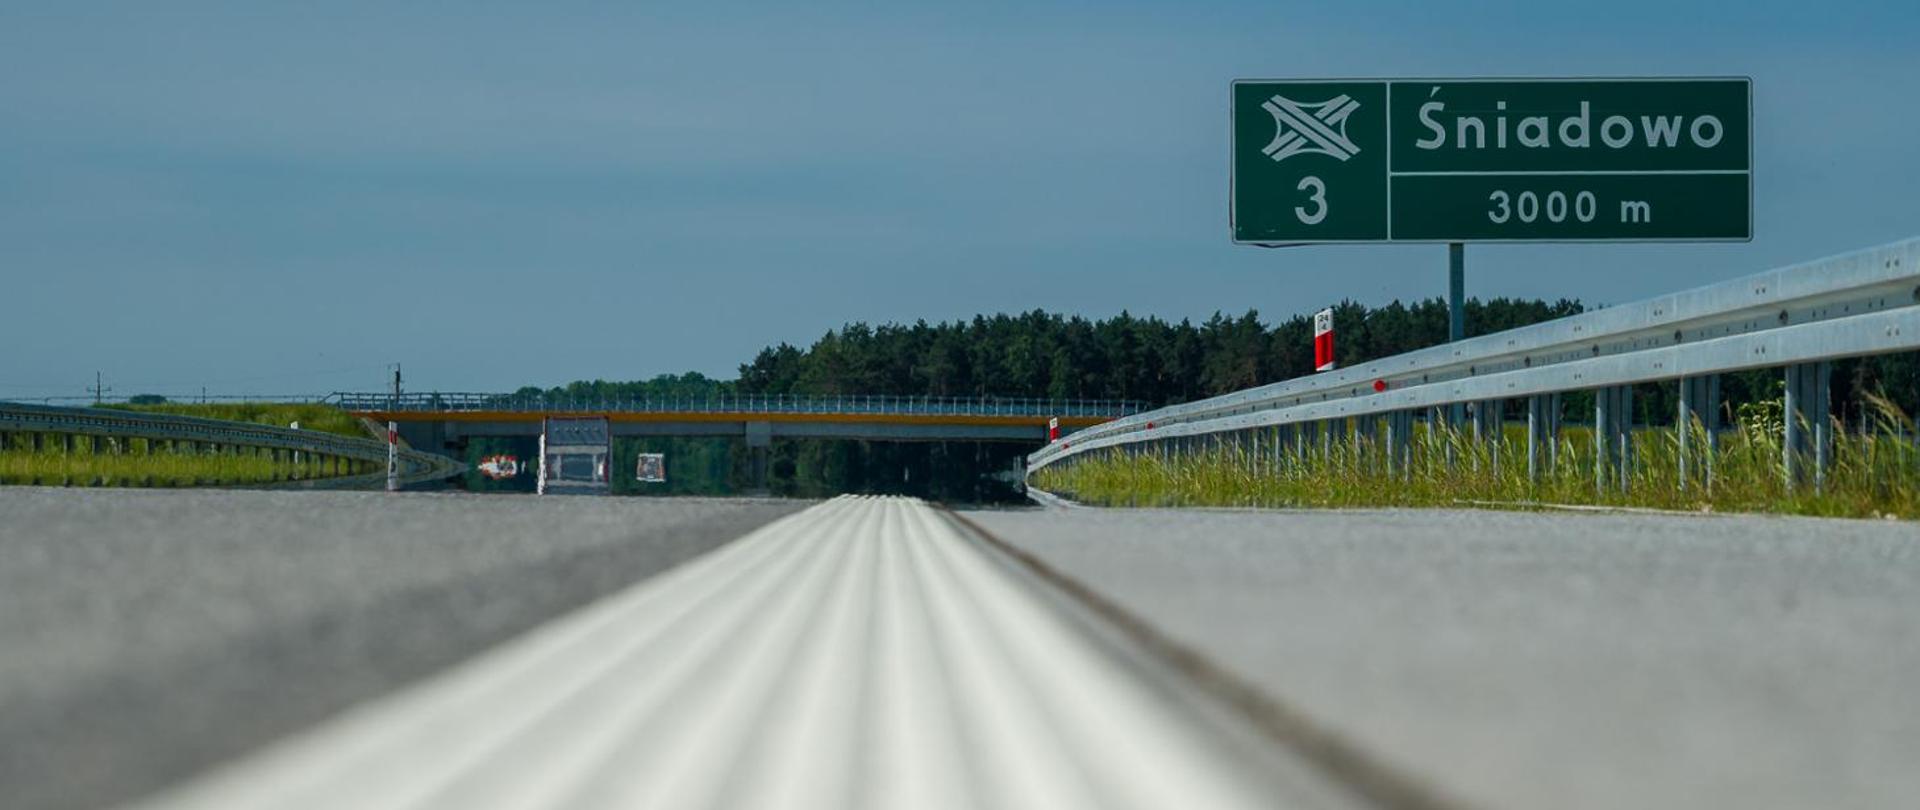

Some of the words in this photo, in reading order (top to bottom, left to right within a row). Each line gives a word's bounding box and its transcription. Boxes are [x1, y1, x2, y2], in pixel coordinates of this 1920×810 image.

[1415, 87, 1724, 150] Śniadowo
[1294, 175, 1328, 225] 3
[1488, 190, 1596, 224] 3000
[1621, 201, 1650, 223] m
